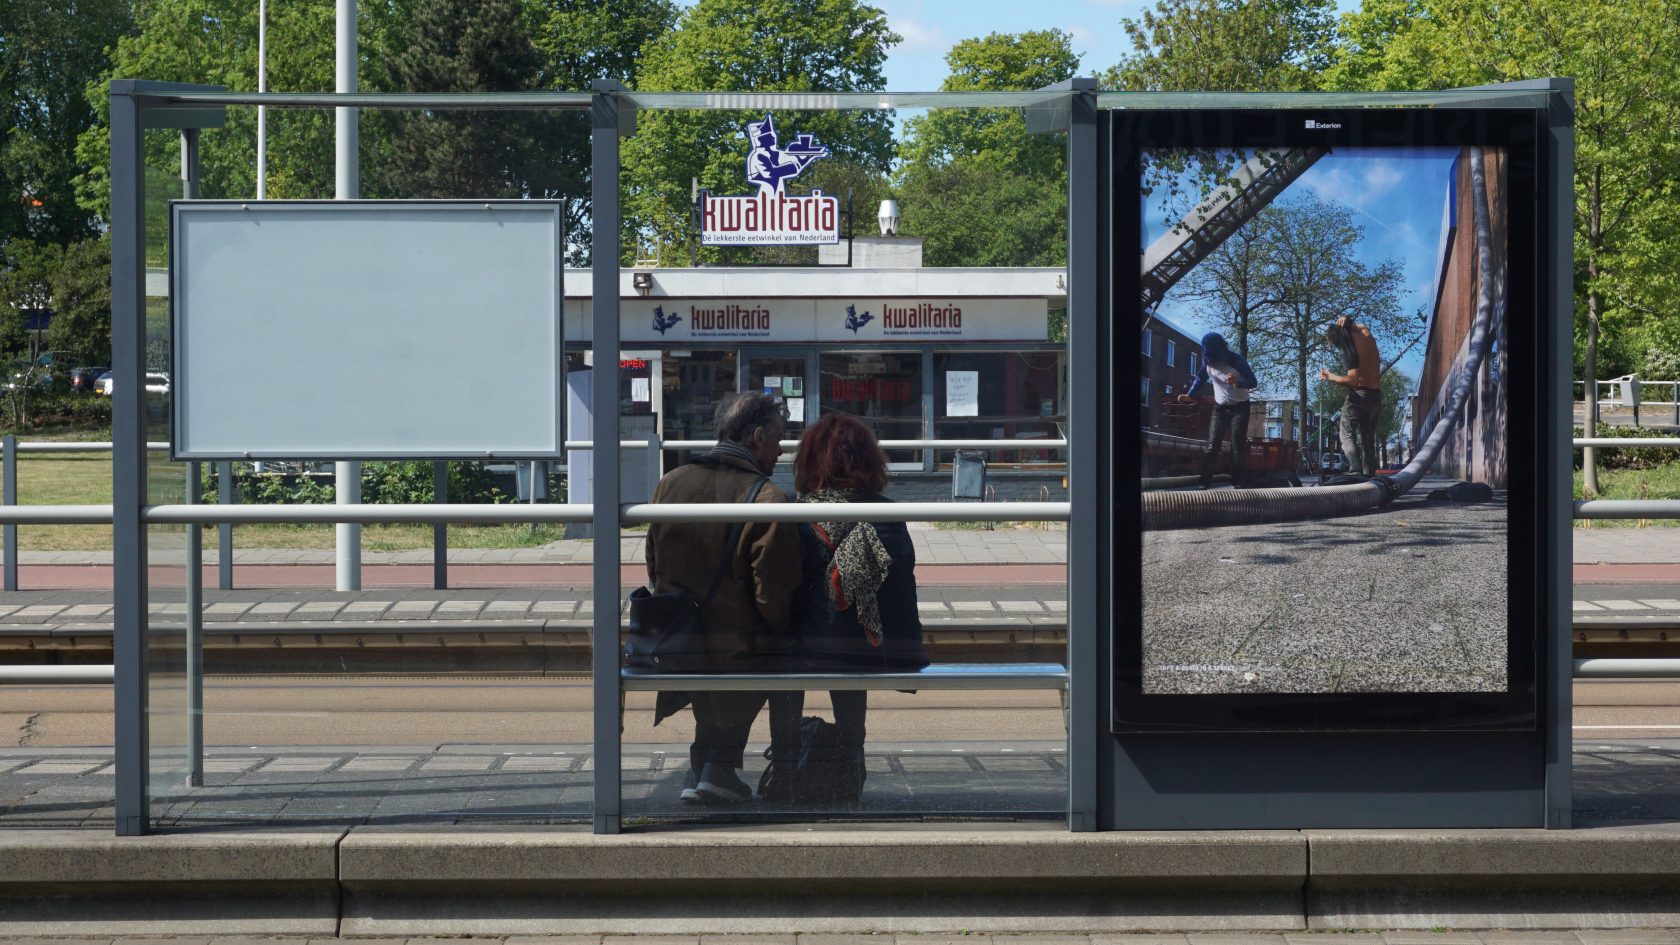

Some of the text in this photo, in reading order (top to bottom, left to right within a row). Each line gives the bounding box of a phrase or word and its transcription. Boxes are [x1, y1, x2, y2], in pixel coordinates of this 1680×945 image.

[702, 190, 835, 232] kwalitaria
[691, 305, 770, 330] kwalitaria
[883, 303, 962, 329] kwalitaria
[619, 359, 646, 368] OPEN
